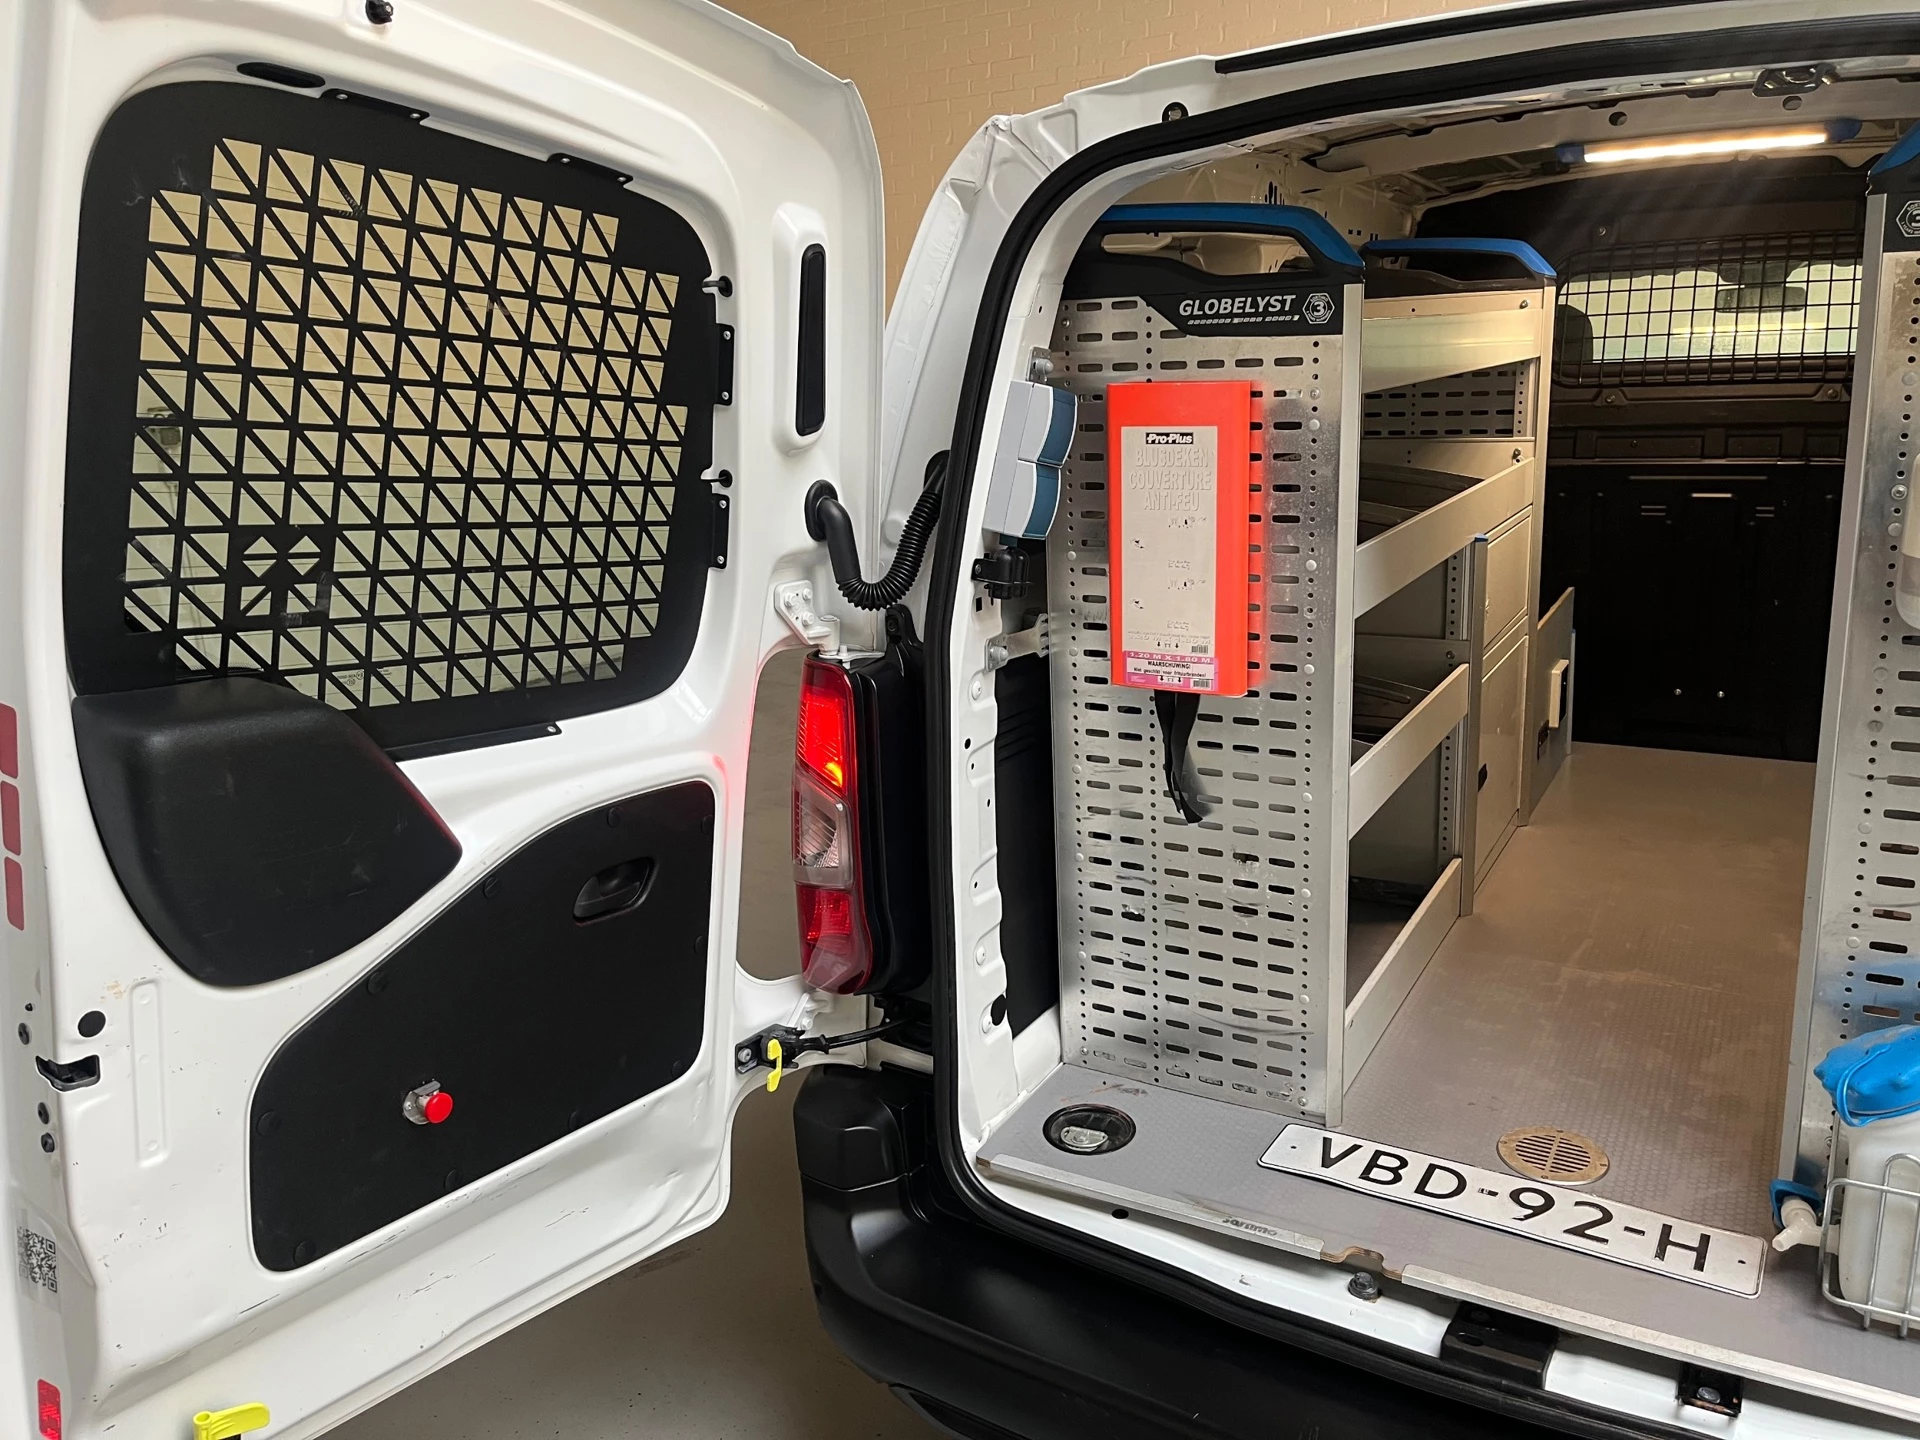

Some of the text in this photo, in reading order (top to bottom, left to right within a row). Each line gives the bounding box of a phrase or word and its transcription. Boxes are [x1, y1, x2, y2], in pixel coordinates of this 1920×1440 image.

[1179, 294, 1296, 316] GLOBELYST
[1313, 301, 1325, 316] 3
[1135, 447, 1209, 468] BLUSDEKEN
[1130, 470, 1212, 491] COUVERTURE
[1144, 491, 1200, 512] ANTI-FEU
[1320, 1136, 1712, 1273] VBD-92-H
